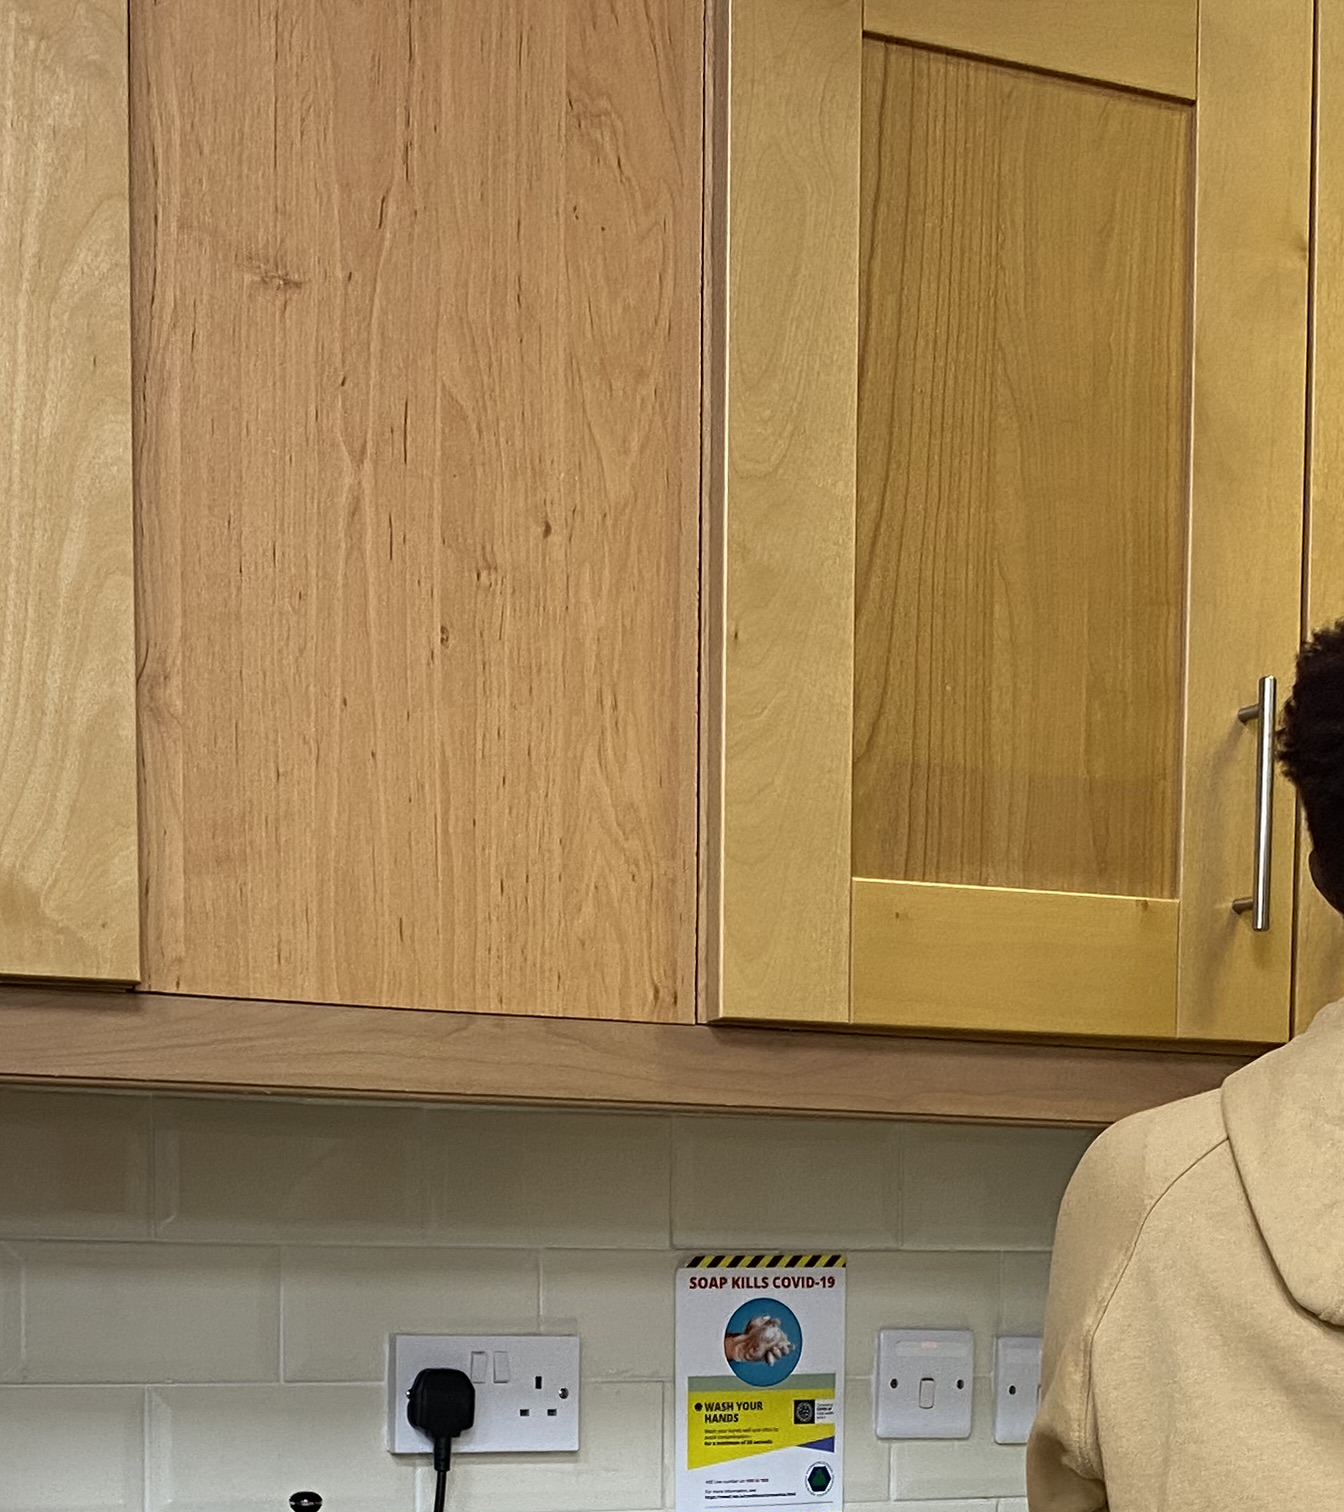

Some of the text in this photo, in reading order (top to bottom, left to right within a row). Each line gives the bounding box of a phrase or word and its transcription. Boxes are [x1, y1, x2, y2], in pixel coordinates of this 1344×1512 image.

[689, 1275, 836, 1290] SOAP KILLS COVID-19
[704, 1400, 764, 1413] WASH YOUR
[704, 1412, 740, 1424] HANDS
